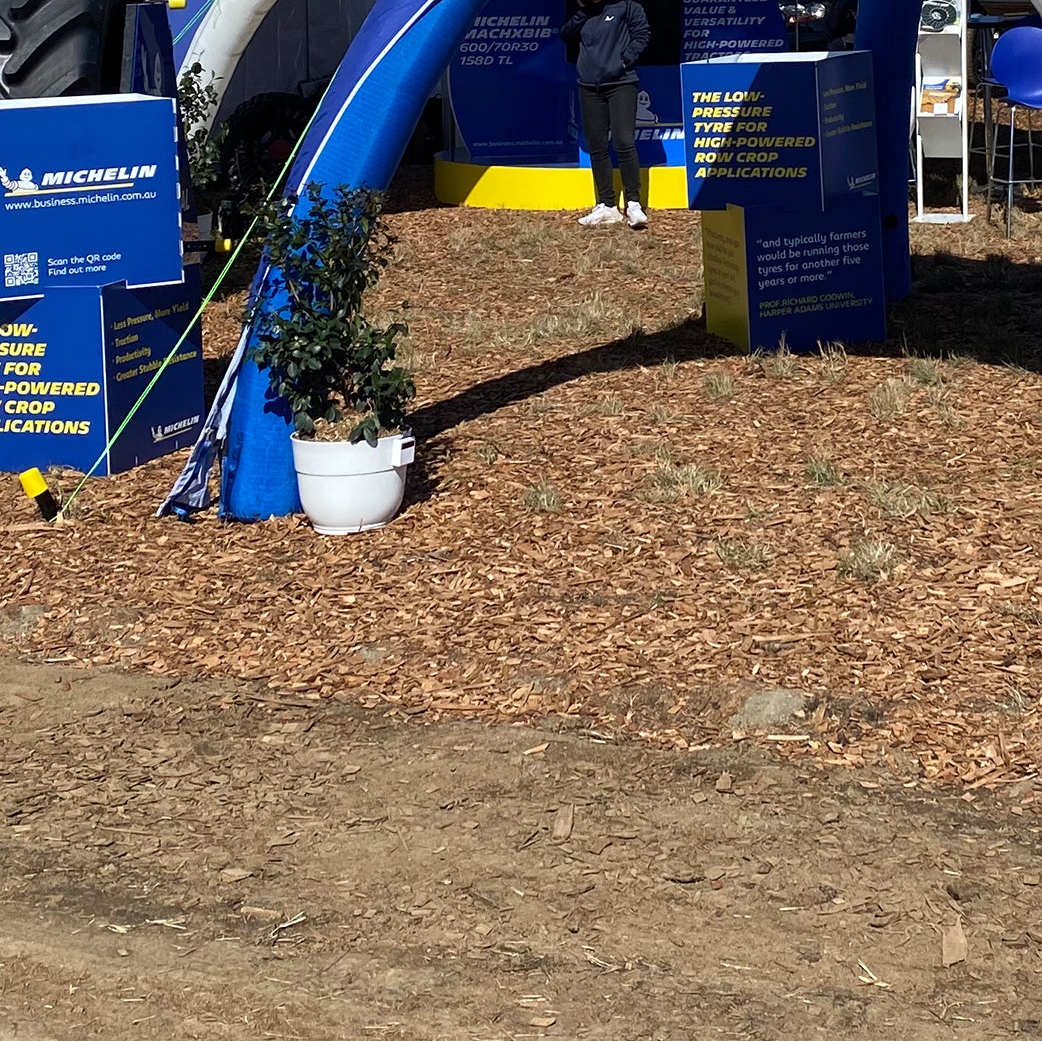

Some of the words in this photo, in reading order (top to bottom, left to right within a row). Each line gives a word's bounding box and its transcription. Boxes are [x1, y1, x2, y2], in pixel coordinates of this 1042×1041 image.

[684, 6, 726, 15] VALUE
[728, 6, 736, 14] &
[684, 16, 766, 26] VERSATILITY
[683, 29, 710, 38] FOR
[459, 41, 540, 53] 600/70R30
[683, 39, 784, 49] HIGH-POWERED
[498, 55, 513, 65] TL
[692, 92, 722, 103] THE
[723, 91, 765, 103] LOW-
[692, 106, 773, 118] PRESSURE
[693, 121, 733, 133] TYRE
[735, 121, 767, 132] FOR
[693, 137, 816, 148] HIGH-POWERED
[694, 152, 734, 163] ROW
[736, 152, 778, 163] CROP
[41, 164, 157, 186] MICHELIN
[694, 167, 808, 178] APPLICATIONS
[5, 191, 157, 211] www.business.michelin.com.au
[783, 233, 827, 248] typically
[829, 230, 867, 241] farmers
[757, 250, 787, 262] would
[789, 249, 800, 259] be
[803, 245, 840, 257] running
[842, 243, 870, 253] those
[47, 257, 68, 266] Scan
[70, 256, 85, 265] the
[86, 254, 100, 264] QR
[101, 252, 122, 262] code
[48, 267, 67, 277] Find
[69, 266, 84, 275] out
[85, 264, 107, 273] more
[757, 265, 783, 277] tyres
[785, 262, 799, 272] for
[801, 258, 840, 270] another
[842, 254, 862, 265] five
[758, 277, 785, 290] years
[787, 276, 798, 284] or
[759, 307, 792, 318] HARPER
[793, 304, 824, 313] ADAMS
[825, 297, 873, 310] UNIVERSITY
[3, 361, 42, 376] FOR
[4, 400, 56, 415] CROP
[163, 414, 200, 435] MICHELIN
